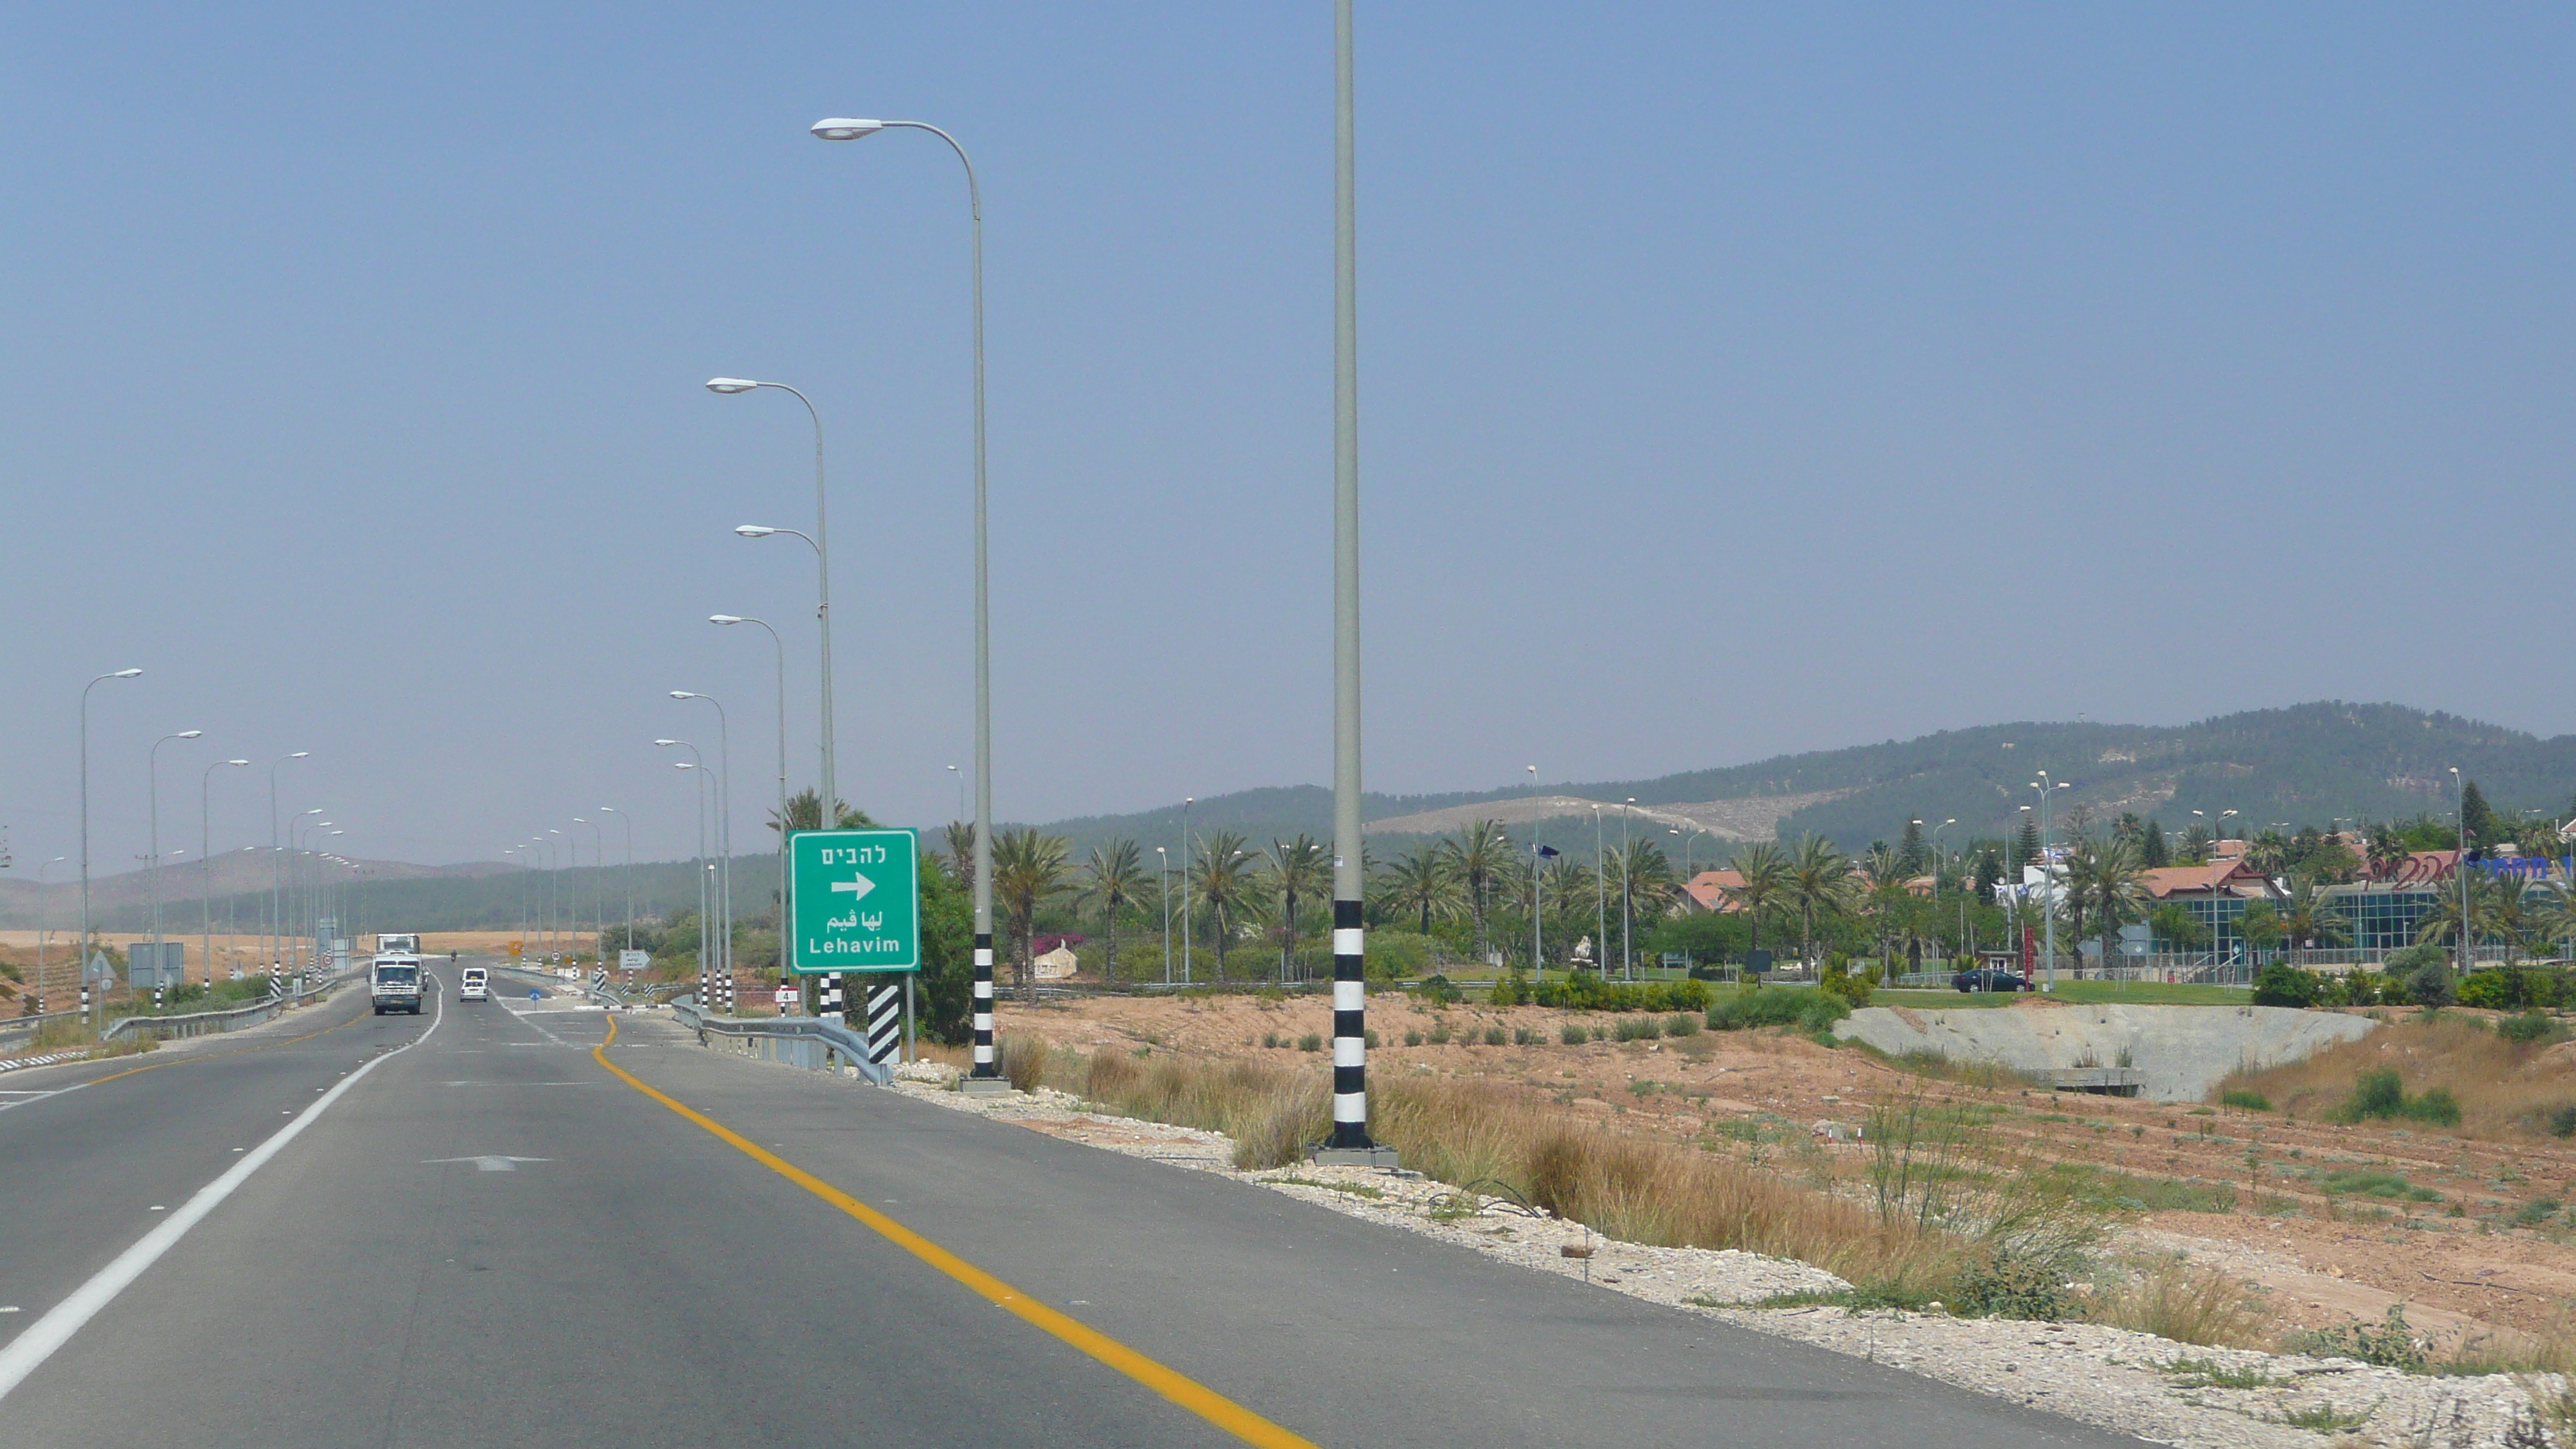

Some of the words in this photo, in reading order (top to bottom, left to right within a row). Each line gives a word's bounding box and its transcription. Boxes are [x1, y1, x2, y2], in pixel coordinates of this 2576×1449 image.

[821, 844, 886, 865] להבים
[810, 937, 899, 954] Lehavim
[783, 992, 789, 1001] 4
